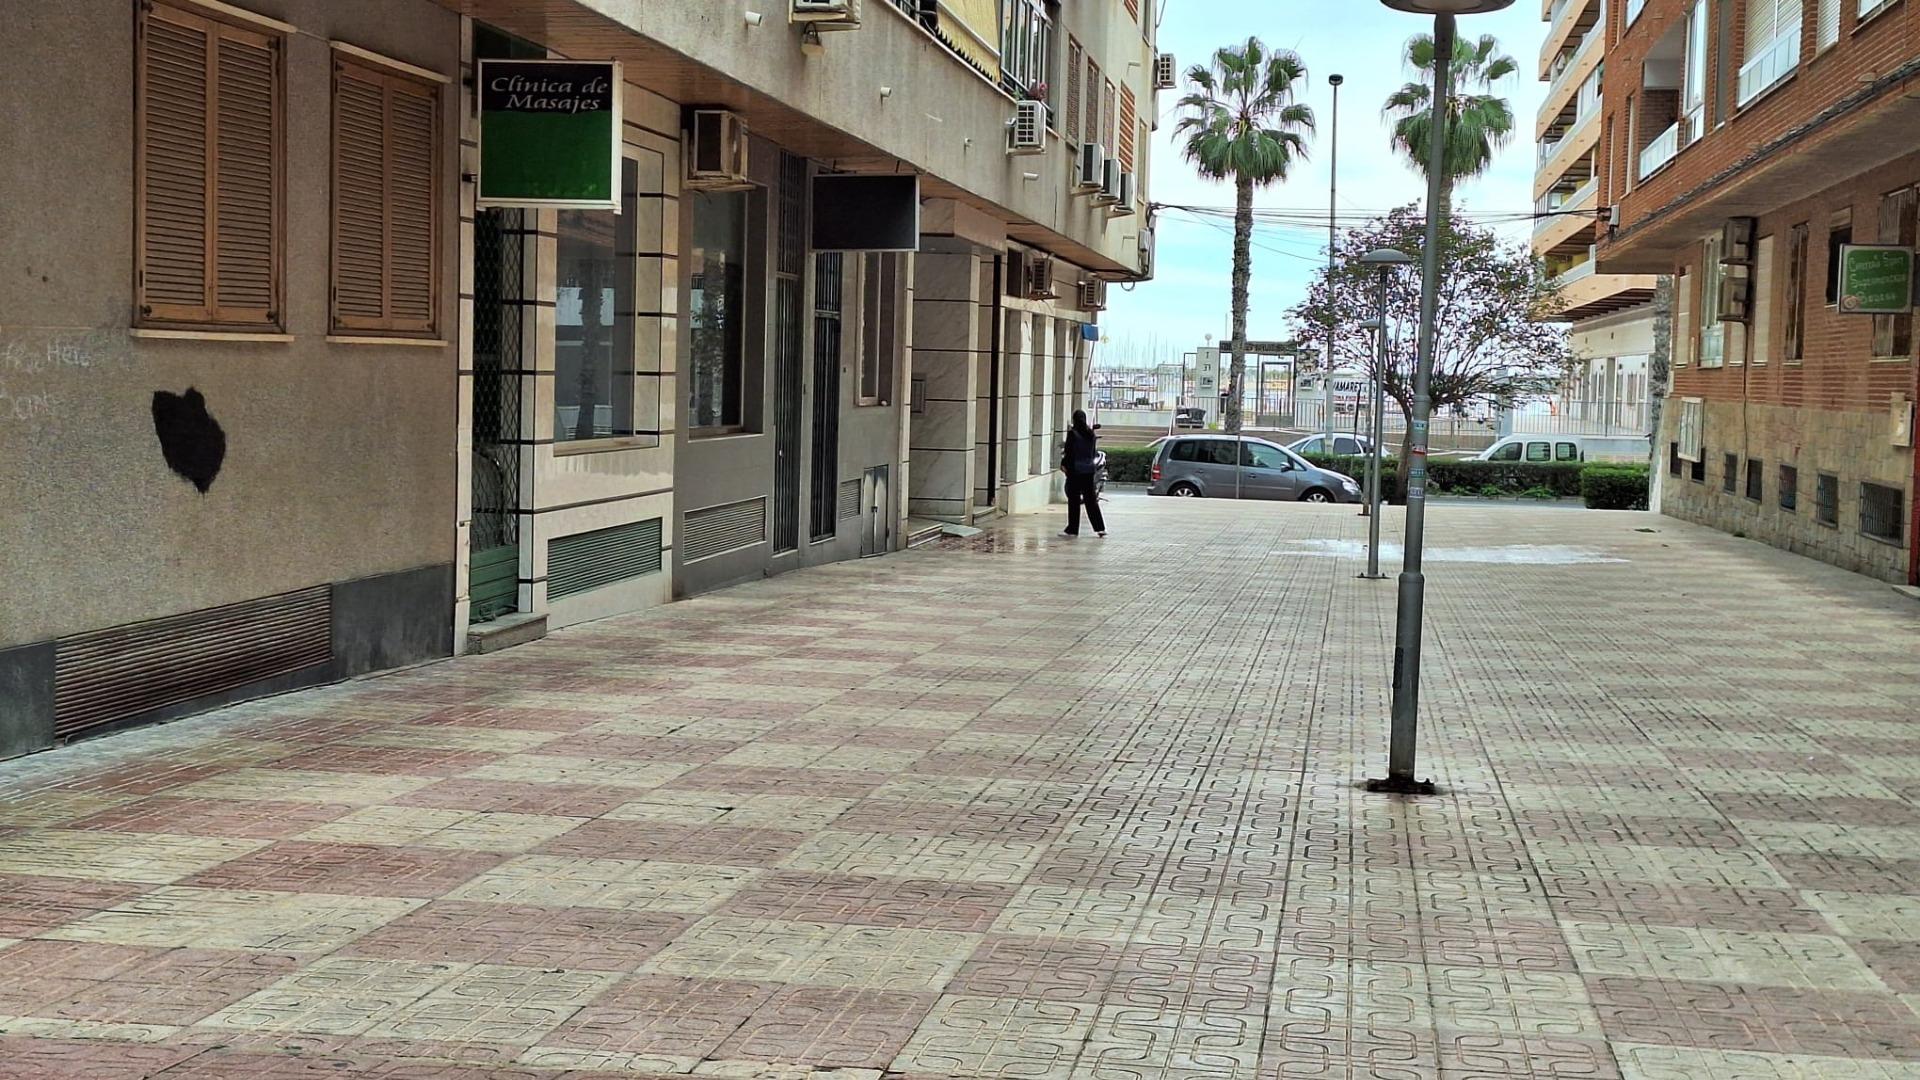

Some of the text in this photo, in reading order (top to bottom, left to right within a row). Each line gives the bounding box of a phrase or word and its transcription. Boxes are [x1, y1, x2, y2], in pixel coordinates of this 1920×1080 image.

[491, 75, 608, 94] Clínica de
[505, 94, 601, 113] Masajes
